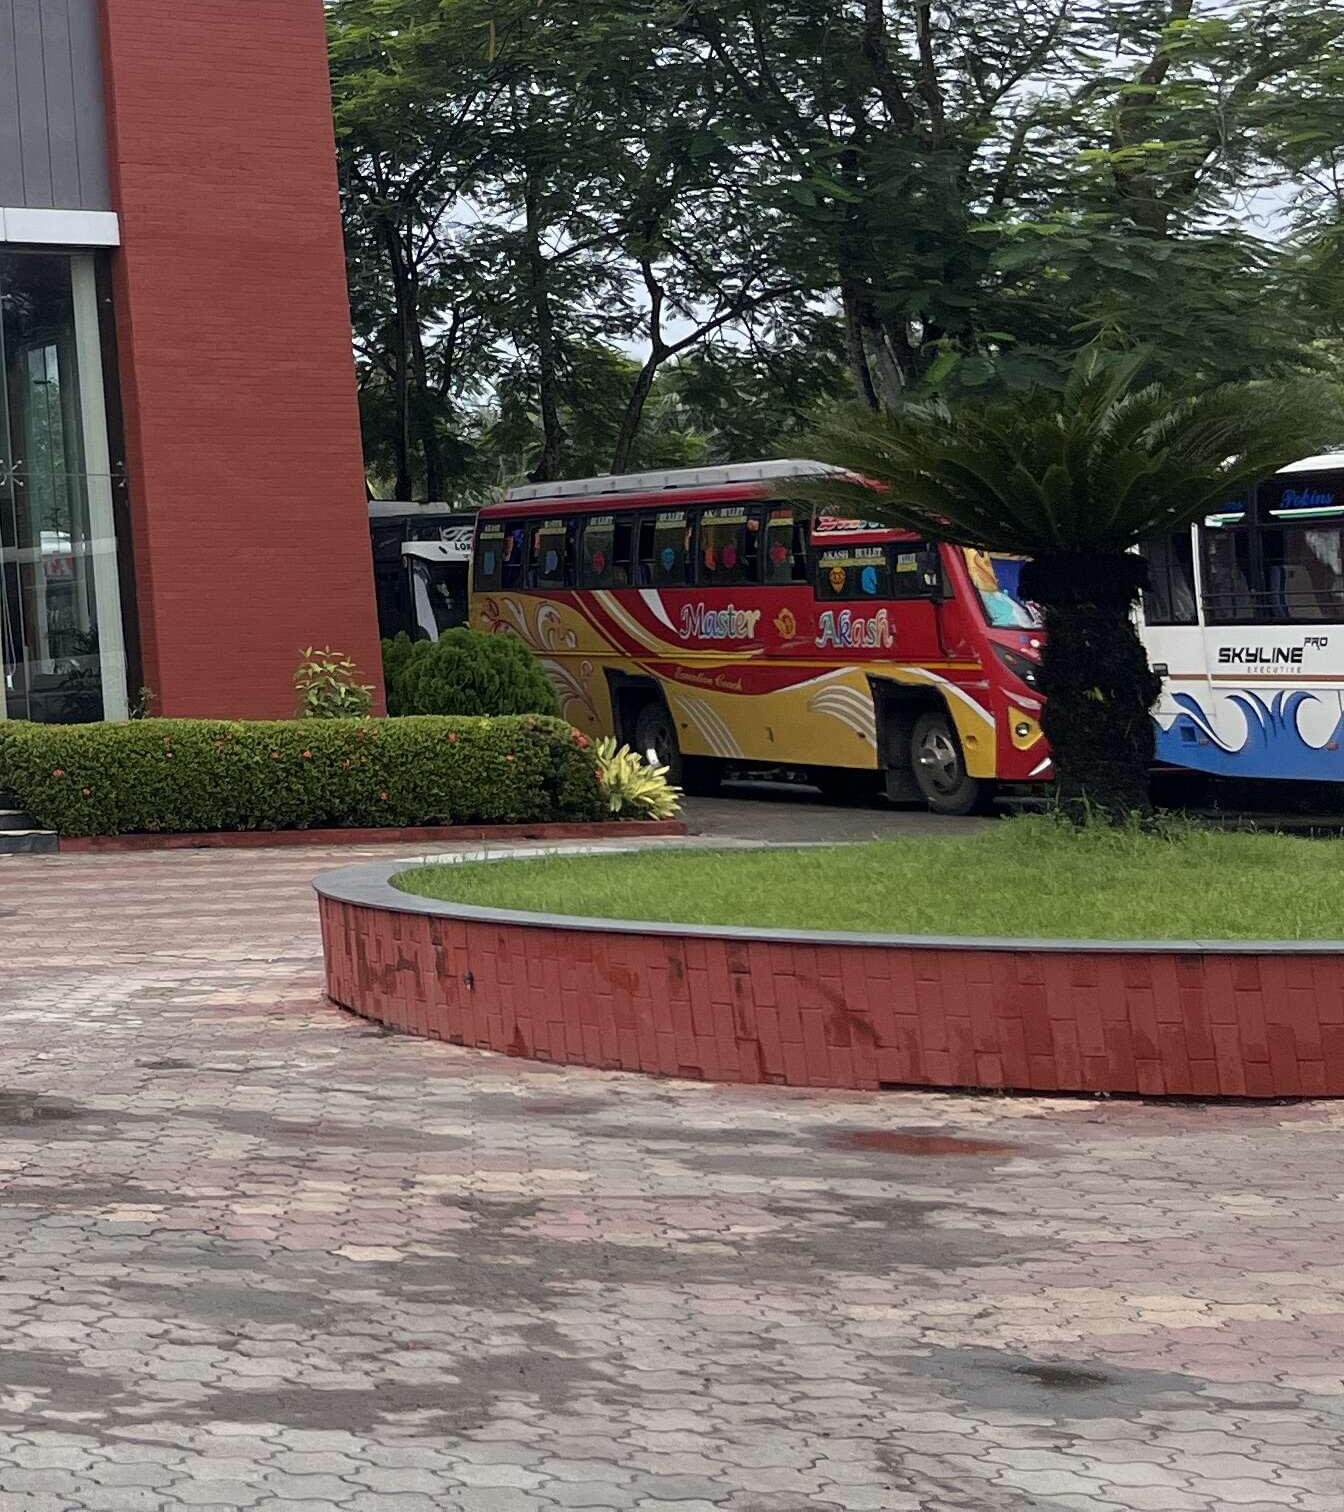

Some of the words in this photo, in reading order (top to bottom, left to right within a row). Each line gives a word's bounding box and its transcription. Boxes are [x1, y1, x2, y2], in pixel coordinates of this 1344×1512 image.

[679, 603, 761, 639] Master
[815, 609, 894, 648] Akash
[1217, 647, 1303, 664] SKYLINE
[1304, 637, 1328, 650] PRO
[1247, 666, 1301, 674] EXECUTIVE
